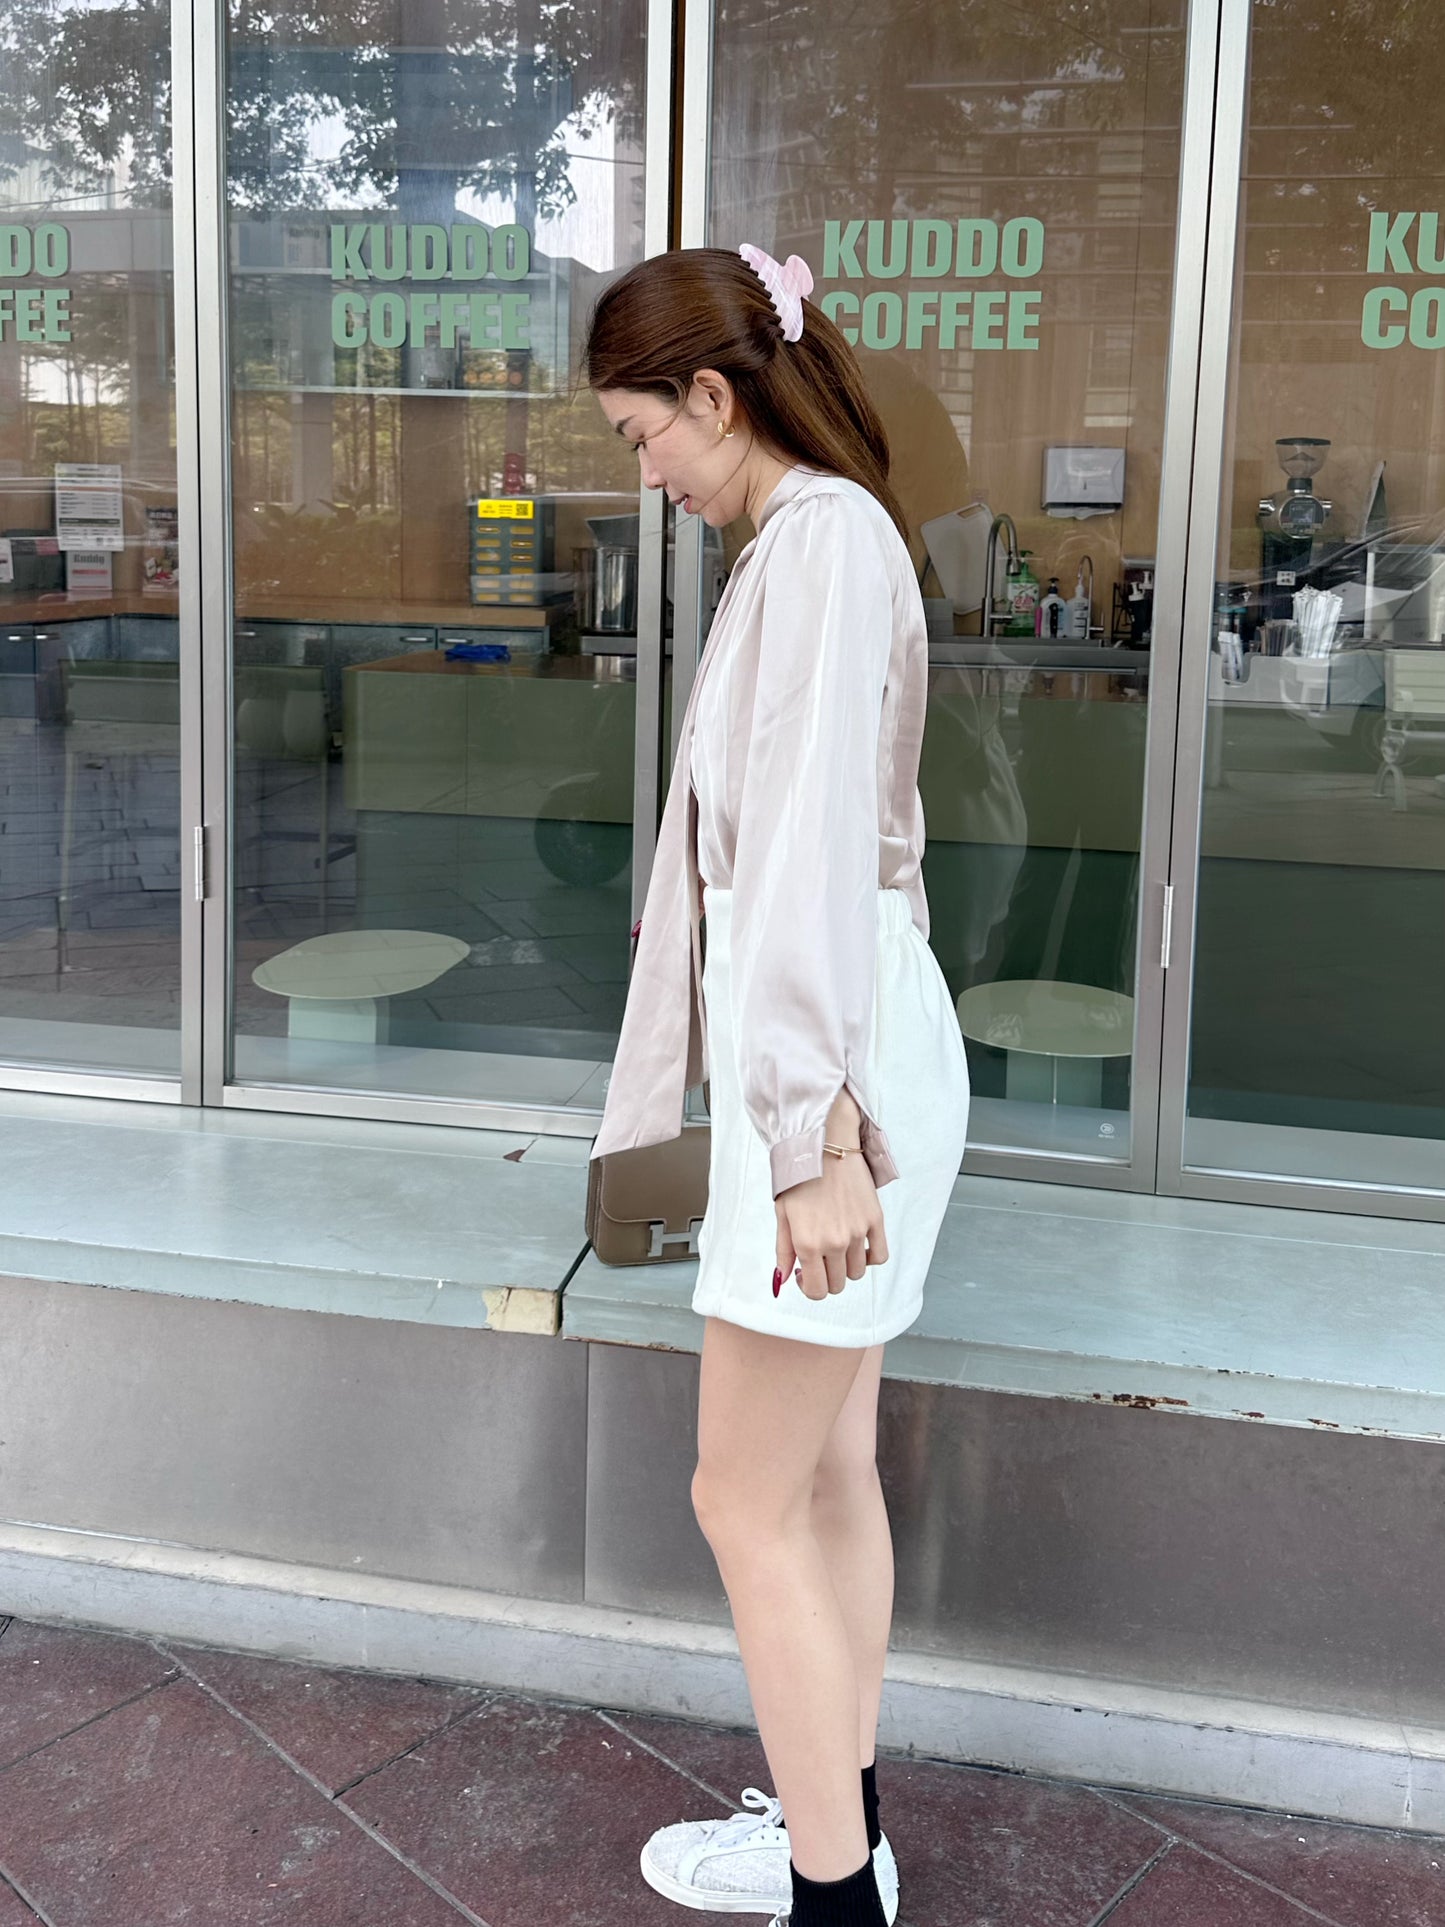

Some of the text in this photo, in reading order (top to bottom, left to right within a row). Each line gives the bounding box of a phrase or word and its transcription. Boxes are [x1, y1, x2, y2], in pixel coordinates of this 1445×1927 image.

[331, 224, 530, 281] KUDDO
[822, 216, 1045, 278] KUDDO
[1366, 211, 1445, 275] KU
[331, 292, 531, 350] COFFEE
[821, 291, 1042, 350] COFFEE
[1361, 286, 1445, 350] CO
